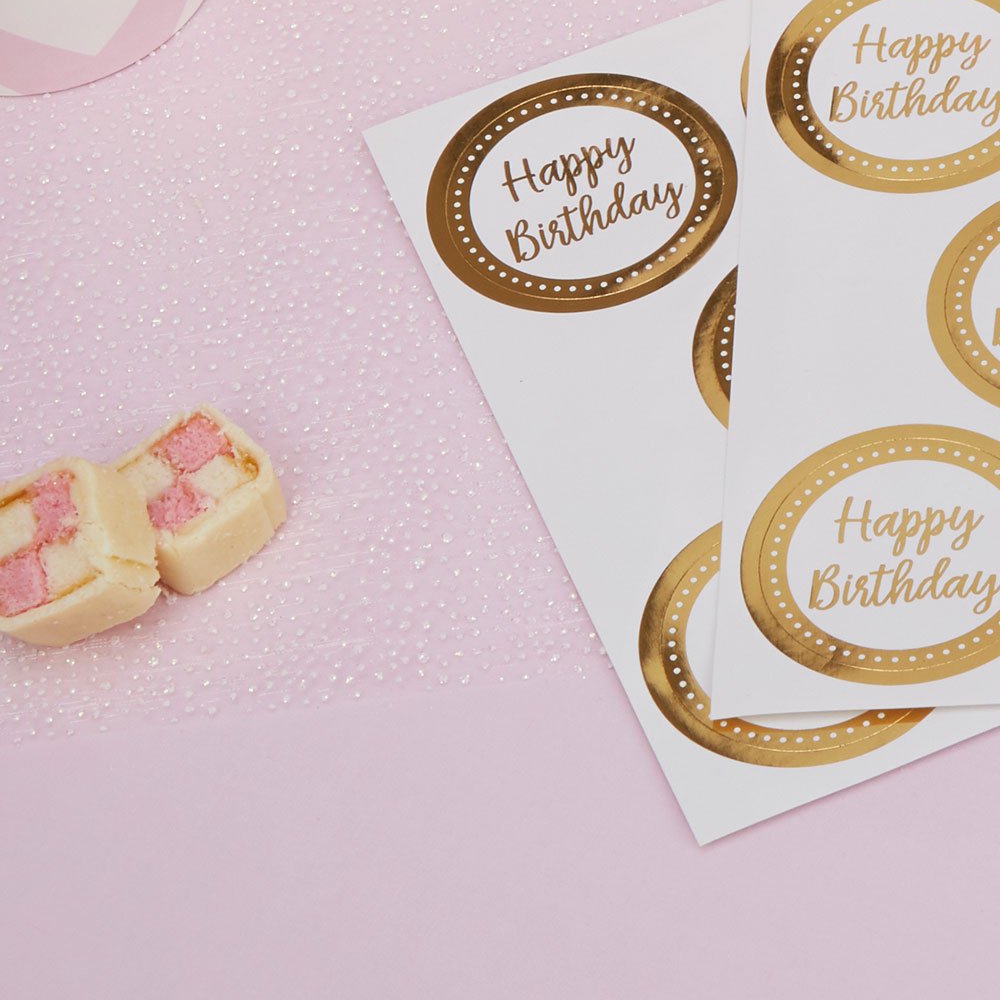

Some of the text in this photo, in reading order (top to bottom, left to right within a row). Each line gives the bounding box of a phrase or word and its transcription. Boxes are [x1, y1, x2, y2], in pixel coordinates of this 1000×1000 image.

[852, 22, 991, 78] Happy
[502, 136, 636, 202] Happy
[505, 182, 684, 264] Birthday
[833, 495, 985, 557] Happy
